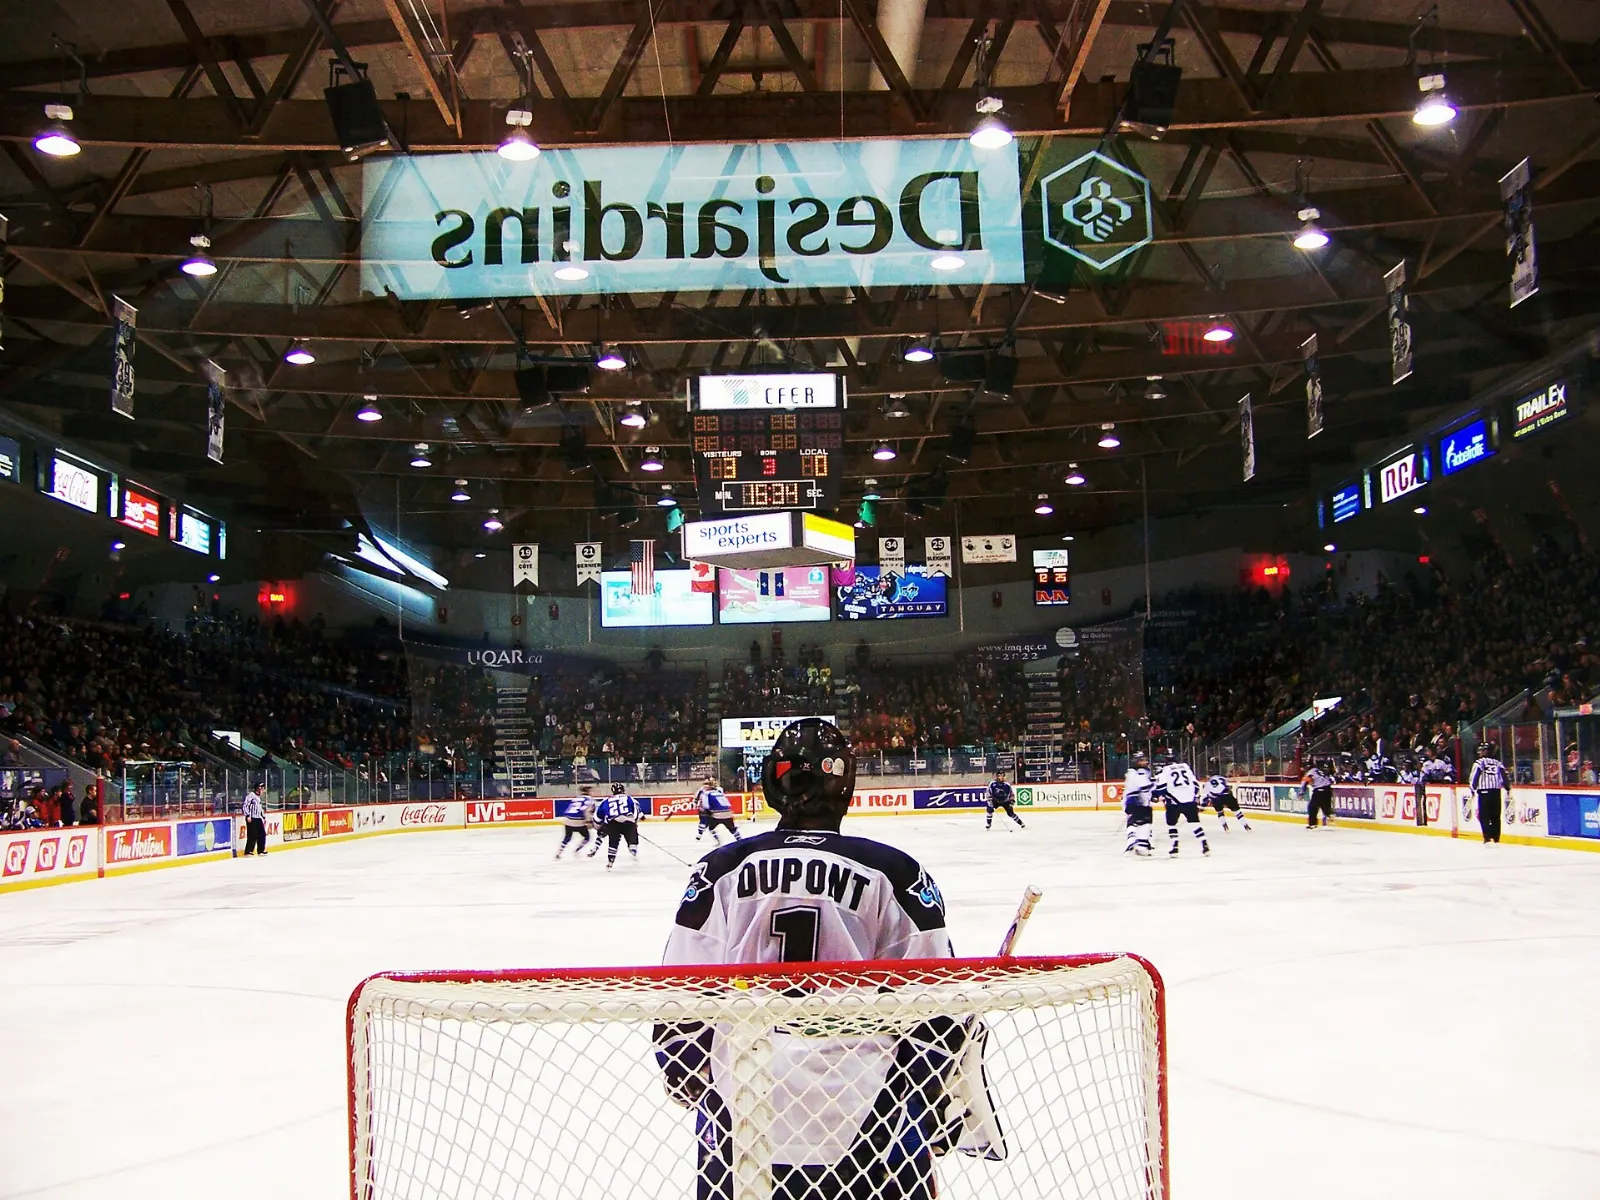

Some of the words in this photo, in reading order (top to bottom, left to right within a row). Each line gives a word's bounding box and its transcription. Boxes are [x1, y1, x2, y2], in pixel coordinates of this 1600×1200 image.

[765, 387, 814, 404] CFER
[703, 450, 742, 458] VISITEURS
[763, 458, 776, 475] 3
[700, 521, 749, 540] sports
[718, 530, 777, 549] experts
[885, 541, 897, 550] 34
[932, 541, 943, 549] 25
[520, 549, 532, 557] 19
[583, 548, 594, 556] 21
[881, 604, 941, 613] TANGUAY
[977, 643, 1048, 653] www.imq.qc.ca
[467, 650, 543, 668] UQAR.ca
[1485, 764, 1498, 774] 33
[1170, 770, 1190, 787] 25
[868, 794, 907, 806] RCA
[954, 793, 986, 803] TELU
[1036, 790, 1092, 805] Desjardins
[400, 804, 448, 826] Coca-Cola
[468, 802, 506, 823] JVC
[608, 800, 629, 816] 22
[114, 831, 131, 861] Tim
[131, 830, 166, 859] Hortons
[737, 858, 870, 911] DUPONT
[769, 905, 821, 963] 1
